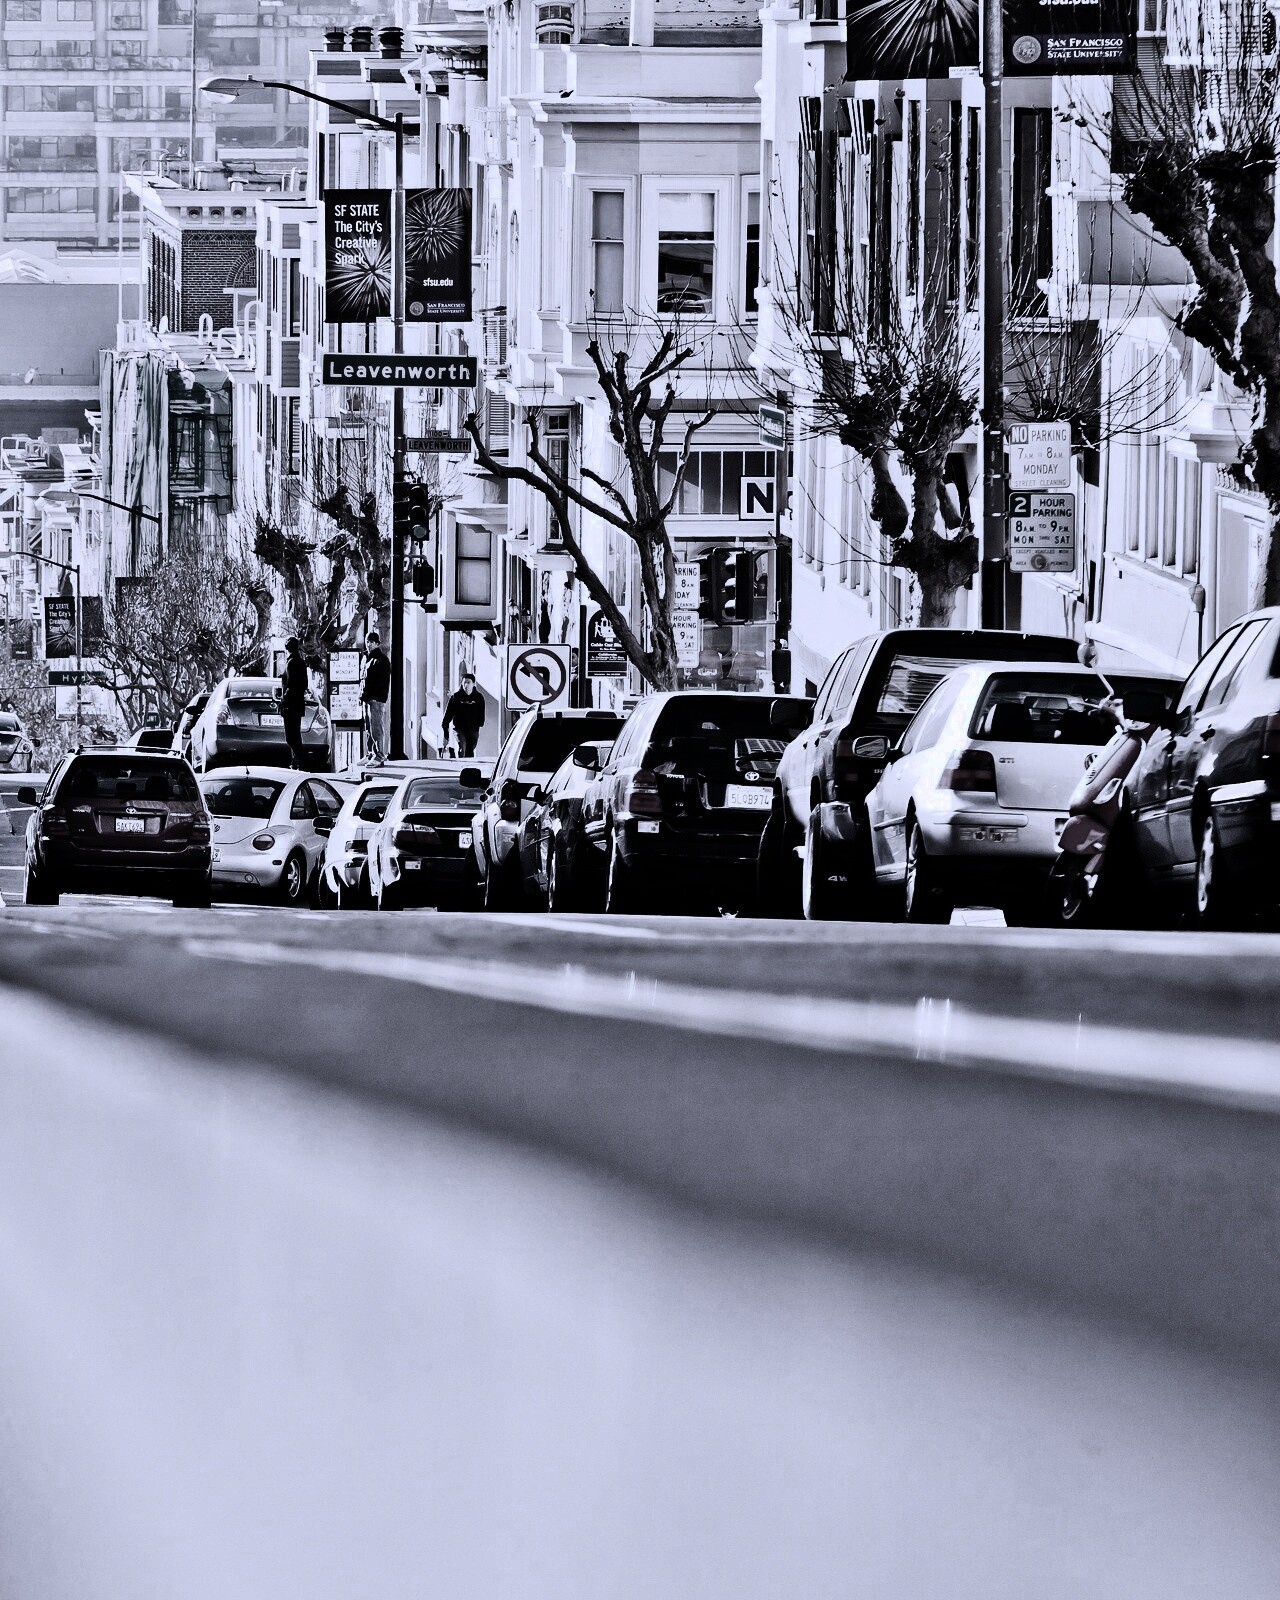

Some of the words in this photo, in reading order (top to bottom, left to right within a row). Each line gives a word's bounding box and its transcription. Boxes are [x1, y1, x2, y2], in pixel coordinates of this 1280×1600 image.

[1047, 38, 1066, 48] SAN
[1069, 37, 1124, 47] FRANCISCO
[1047, 50, 1072, 59] STATE
[1073, 49, 1123, 58] UNIVERSITY
[334, 204, 348, 217] SF
[349, 204, 380, 217] STATE
[334, 220, 353, 233] The
[355, 220, 383, 234] City's
[335, 236, 378, 249] Creative
[334, 253, 366, 267] Spark
[423, 277, 454, 287] sfsu.edu
[329, 361, 471, 381] Leavenworth
[1011, 425, 1028, 443] NO
[1031, 429, 1067, 442] PARKING
[408, 440, 469, 451] LEAVENWORTH
[1023, 463, 1059, 475] MONDAY
[1040, 478, 1066, 487] CLEANING
[1014, 496, 1027, 513] 2
[1039, 498, 1065, 507] HOUR
[1032, 508, 1072, 518] PARKING
[1013, 535, 1034, 544] MON
[1054, 535, 1071, 544] SAT
[675, 567, 698, 576] ARKING
[675, 591, 690, 599] IDAY
[331, 686, 338, 695] 2
